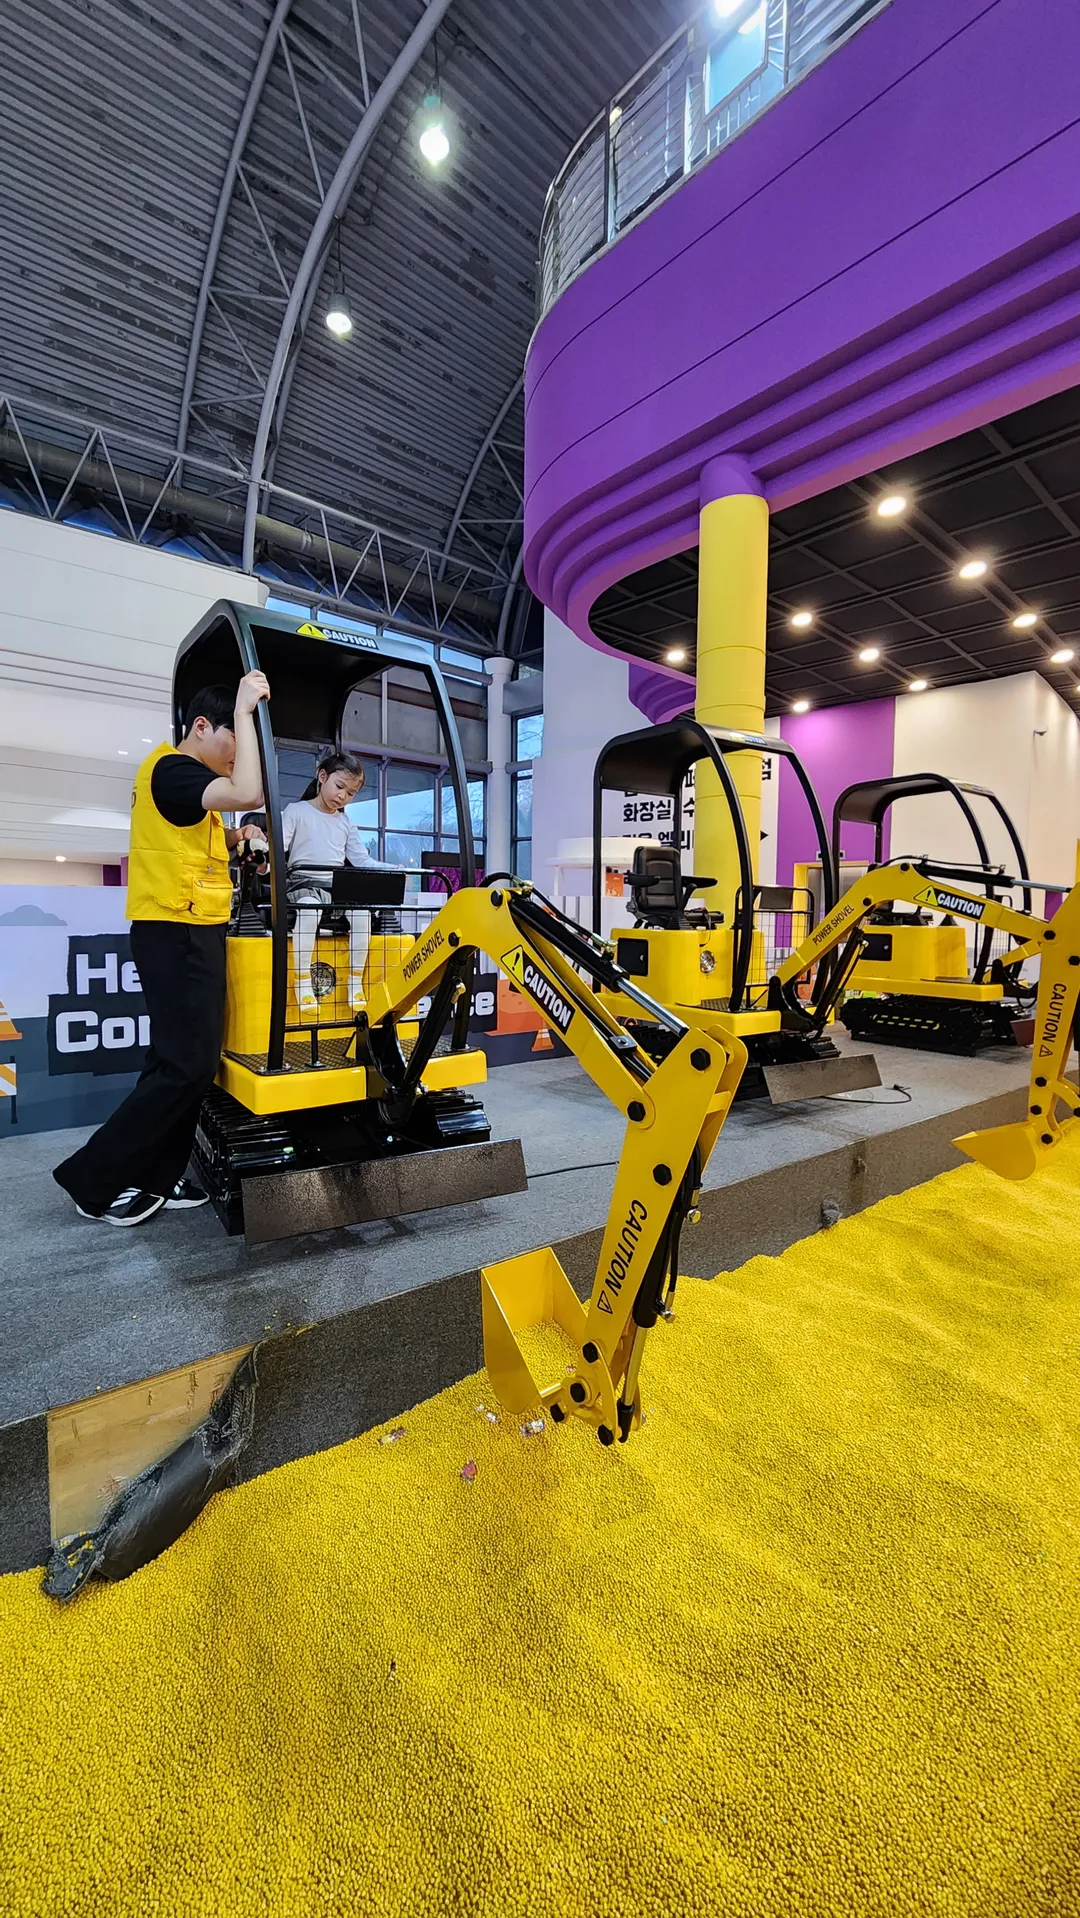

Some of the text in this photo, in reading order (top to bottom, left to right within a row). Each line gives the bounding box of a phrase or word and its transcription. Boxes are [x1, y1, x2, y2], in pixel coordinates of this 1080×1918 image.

[322, 629, 376, 648] CAUTION
[623, 799, 671, 822] 화장실
[812, 904, 855, 945] POWER SHOVEL
[937, 893, 983, 916] CAUTION
[76, 953, 143, 995] He
[402, 929, 445, 982] POWER SHOVEL
[524, 965, 572, 1027] CAUTION
[1042, 983, 1067, 1043] CAUTION
[605, 1200, 648, 1297] CAUTION
